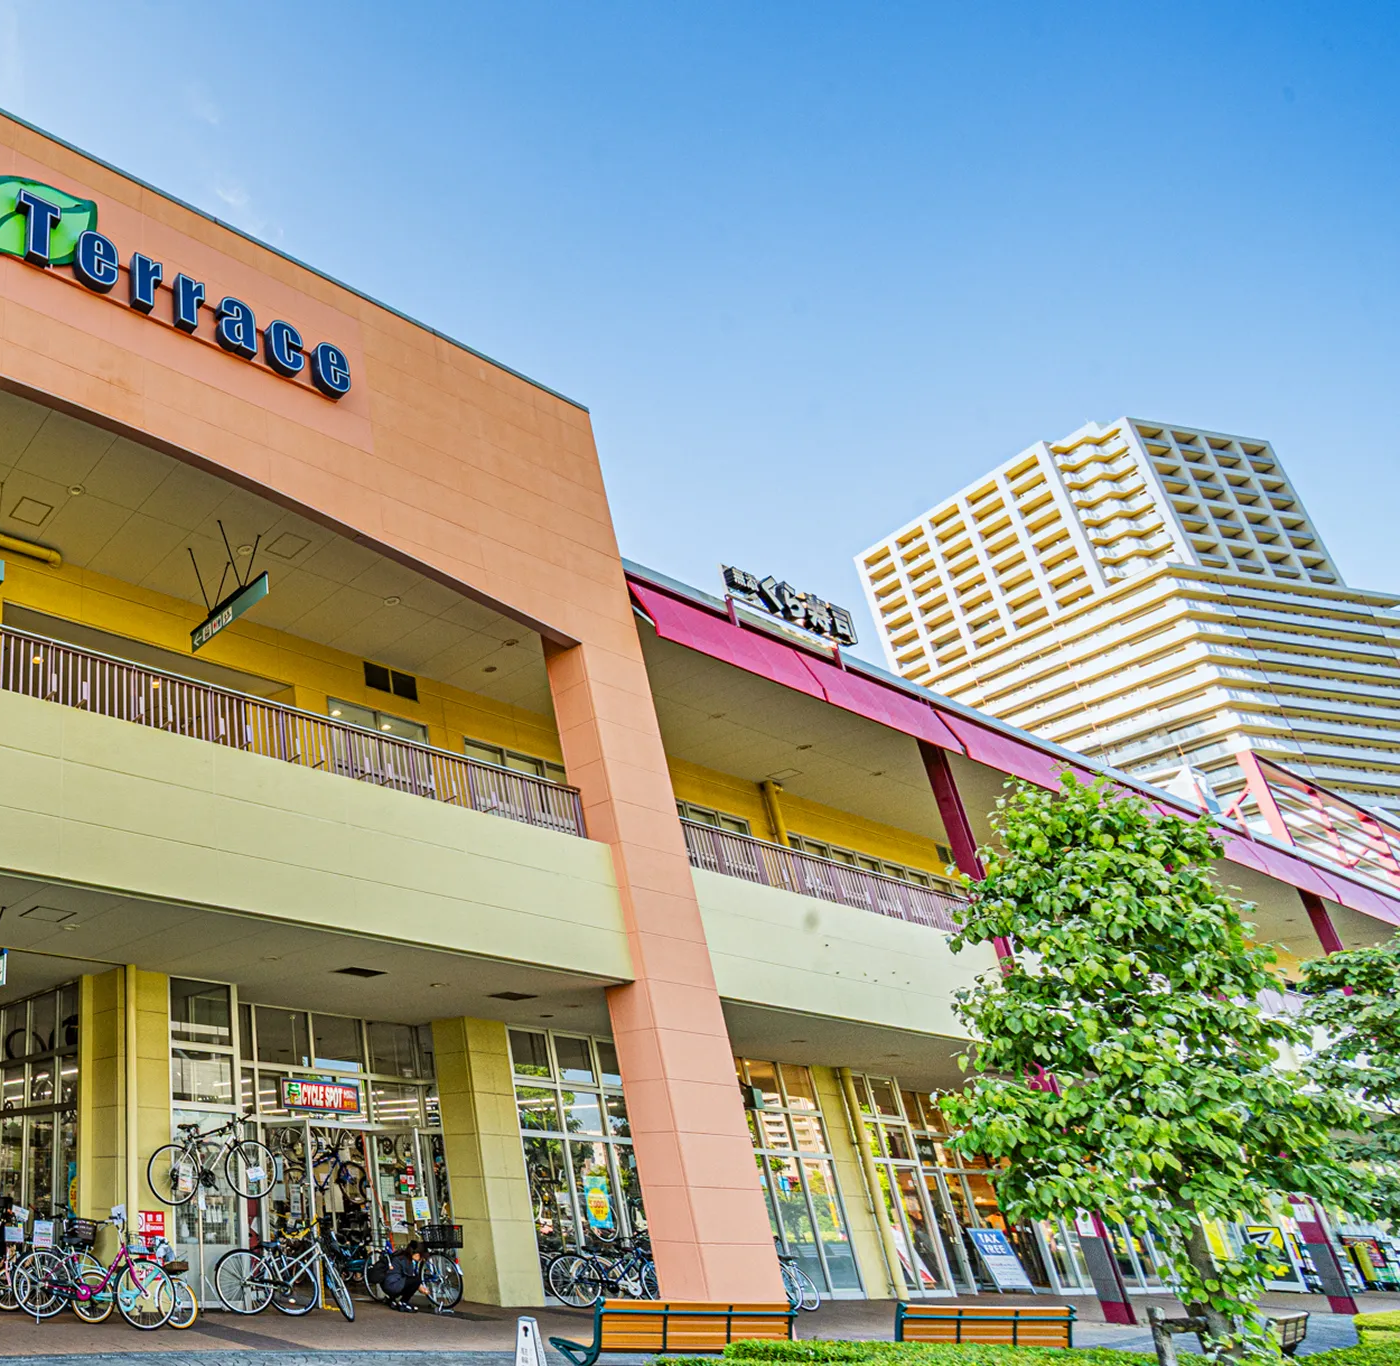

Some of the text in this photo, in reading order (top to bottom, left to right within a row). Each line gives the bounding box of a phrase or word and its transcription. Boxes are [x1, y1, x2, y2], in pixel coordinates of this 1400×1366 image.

[15, 187, 351, 400] Terrace
[758, 575, 858, 645] くら寿司
[302, 1084, 324, 1107] CYCLE
[325, 1086, 342, 1108] SPOT
[977, 1233, 1000, 1244] TAX
[983, 1244, 1007, 1254] FREE
